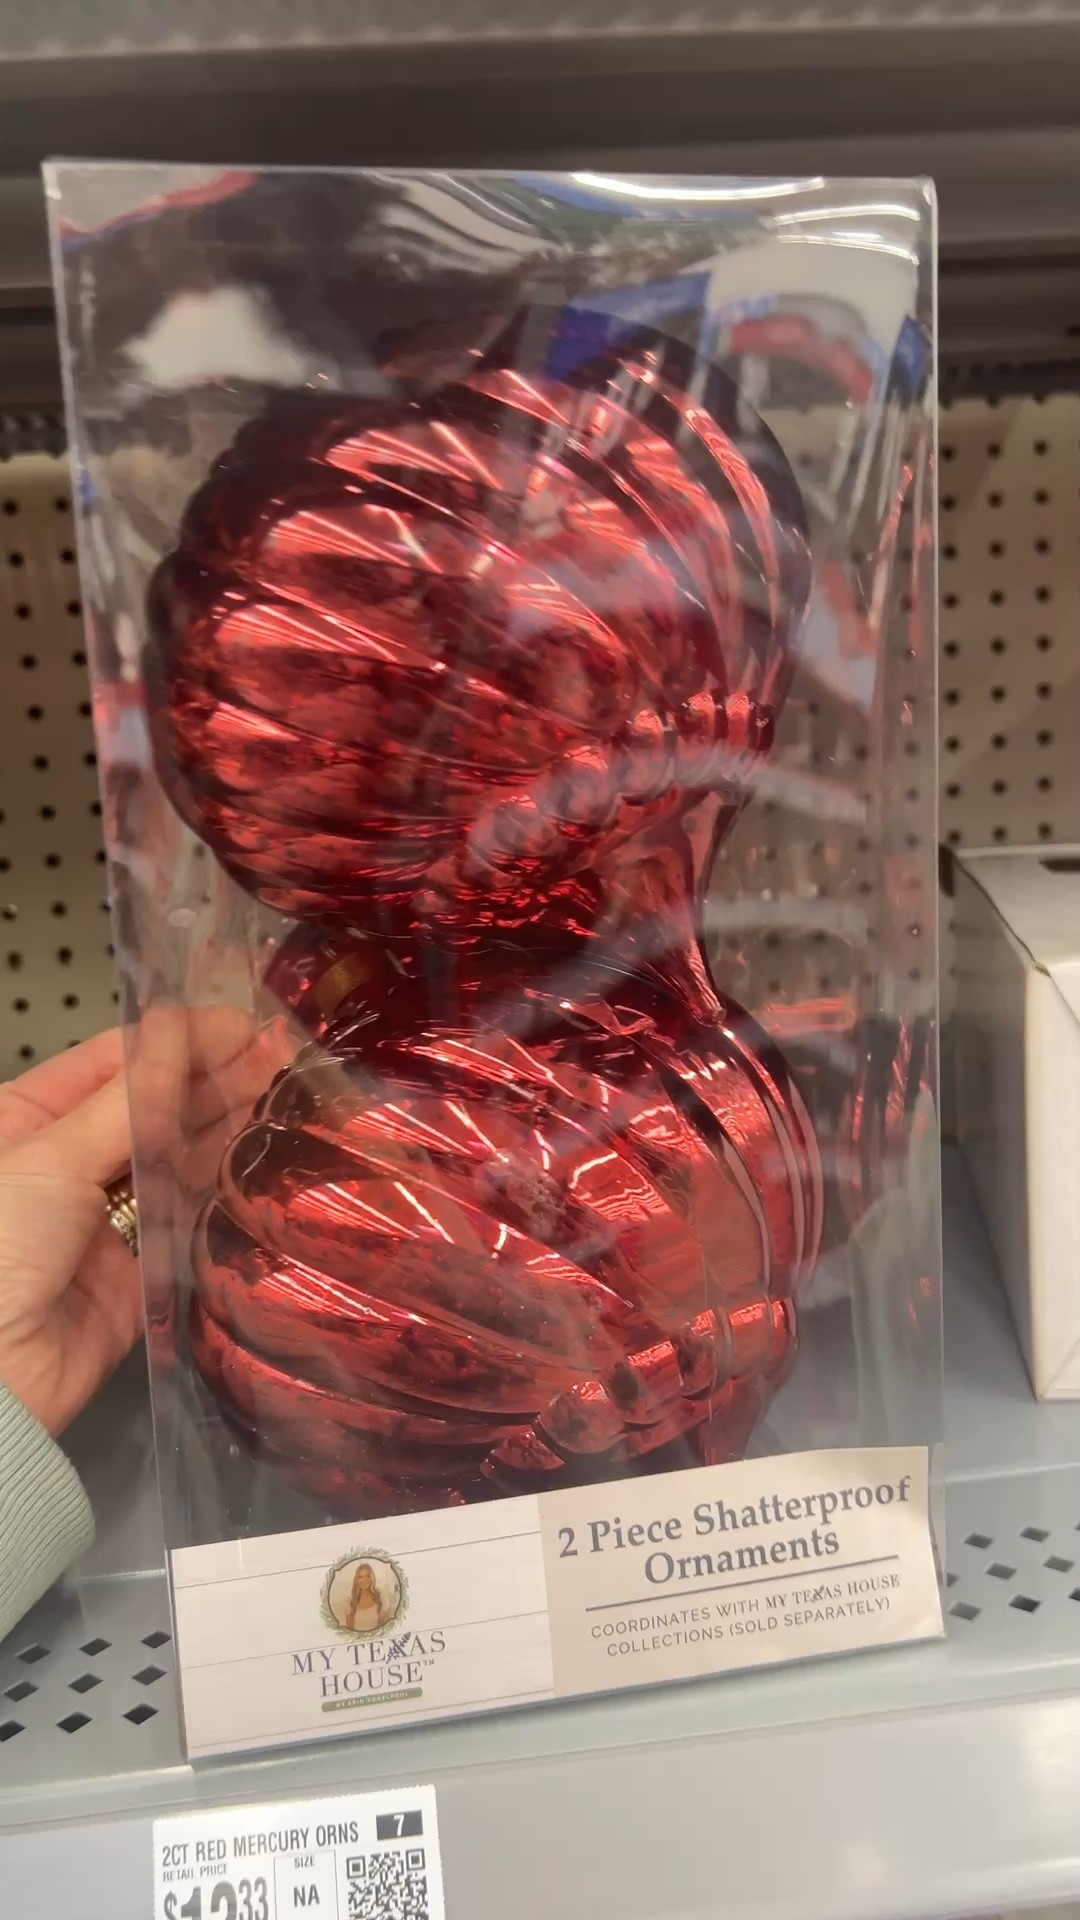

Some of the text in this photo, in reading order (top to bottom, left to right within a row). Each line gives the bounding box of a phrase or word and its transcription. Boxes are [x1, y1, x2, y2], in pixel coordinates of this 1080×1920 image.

[558, 1475, 911, 1558] 2 Piece Shatterproof
[645, 1528, 839, 1584] Ornaments
[591, 1573, 900, 1638] COORDINATES WITH MY TEXAS HOUSE
[607, 1596, 890, 1656] COLLECTIONS (SOLD SEPARATELY)
[291, 1631, 446, 1676] MY TEXAS
[161, 1821, 359, 1867] 2CT RED MERCURY ORNS
[393, 1814, 405, 1836] 7
[162, 1863, 228, 1882] RETAIL PRICE
[294, 1857, 315, 1869] SIZE
[293, 1884, 320, 1907] NA
